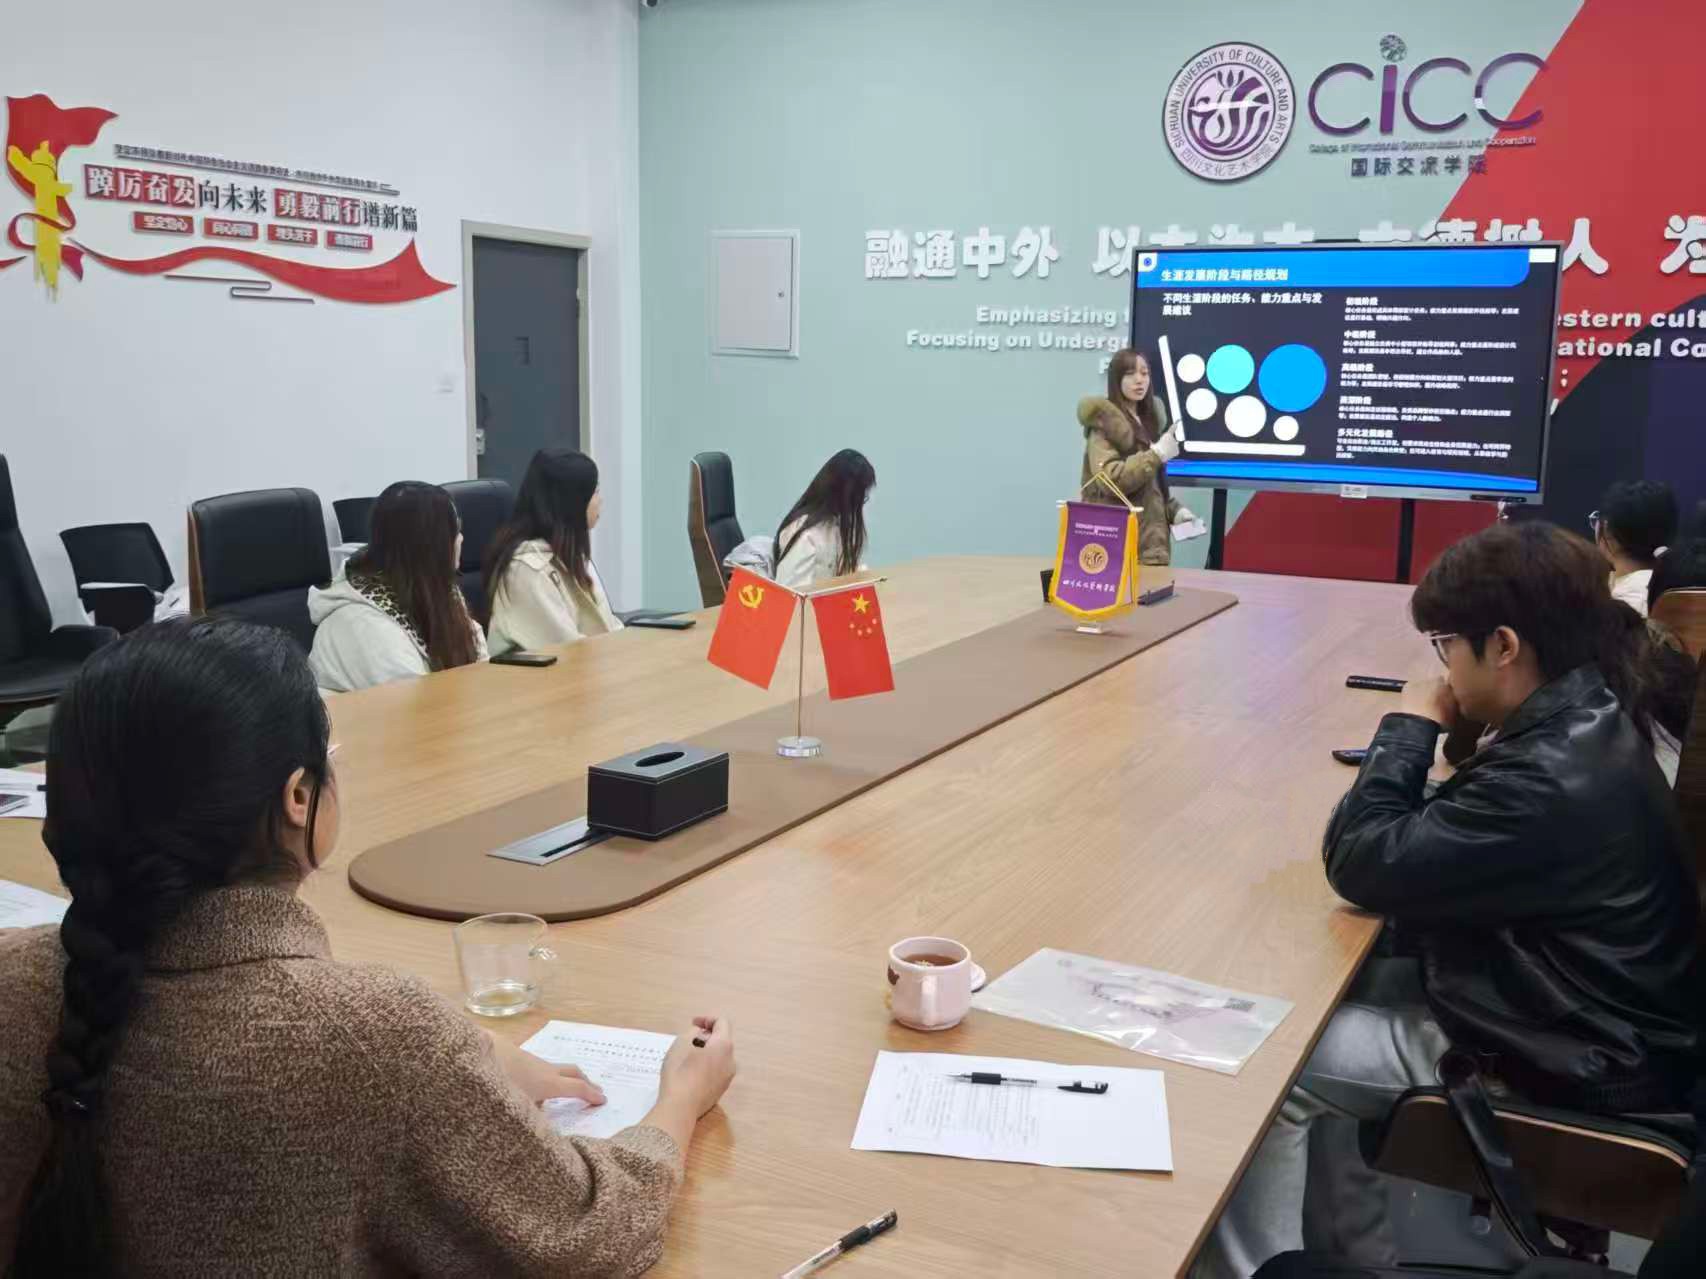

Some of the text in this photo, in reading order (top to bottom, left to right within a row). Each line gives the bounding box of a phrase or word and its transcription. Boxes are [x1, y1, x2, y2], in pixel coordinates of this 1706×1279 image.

[1168, 48, 1290, 149] SICHUAN UNIVERSITY OF CULTURE AND ARTS
[1350, 154, 1488, 177] 国际交流学院
[864, 226, 1060, 279] 融通中外
[976, 305, 1118, 327] Emphasizing
[1557, 309, 1642, 328] stern
[906, 330, 1000, 351] Focusing
[1005, 335, 1031, 348] on
